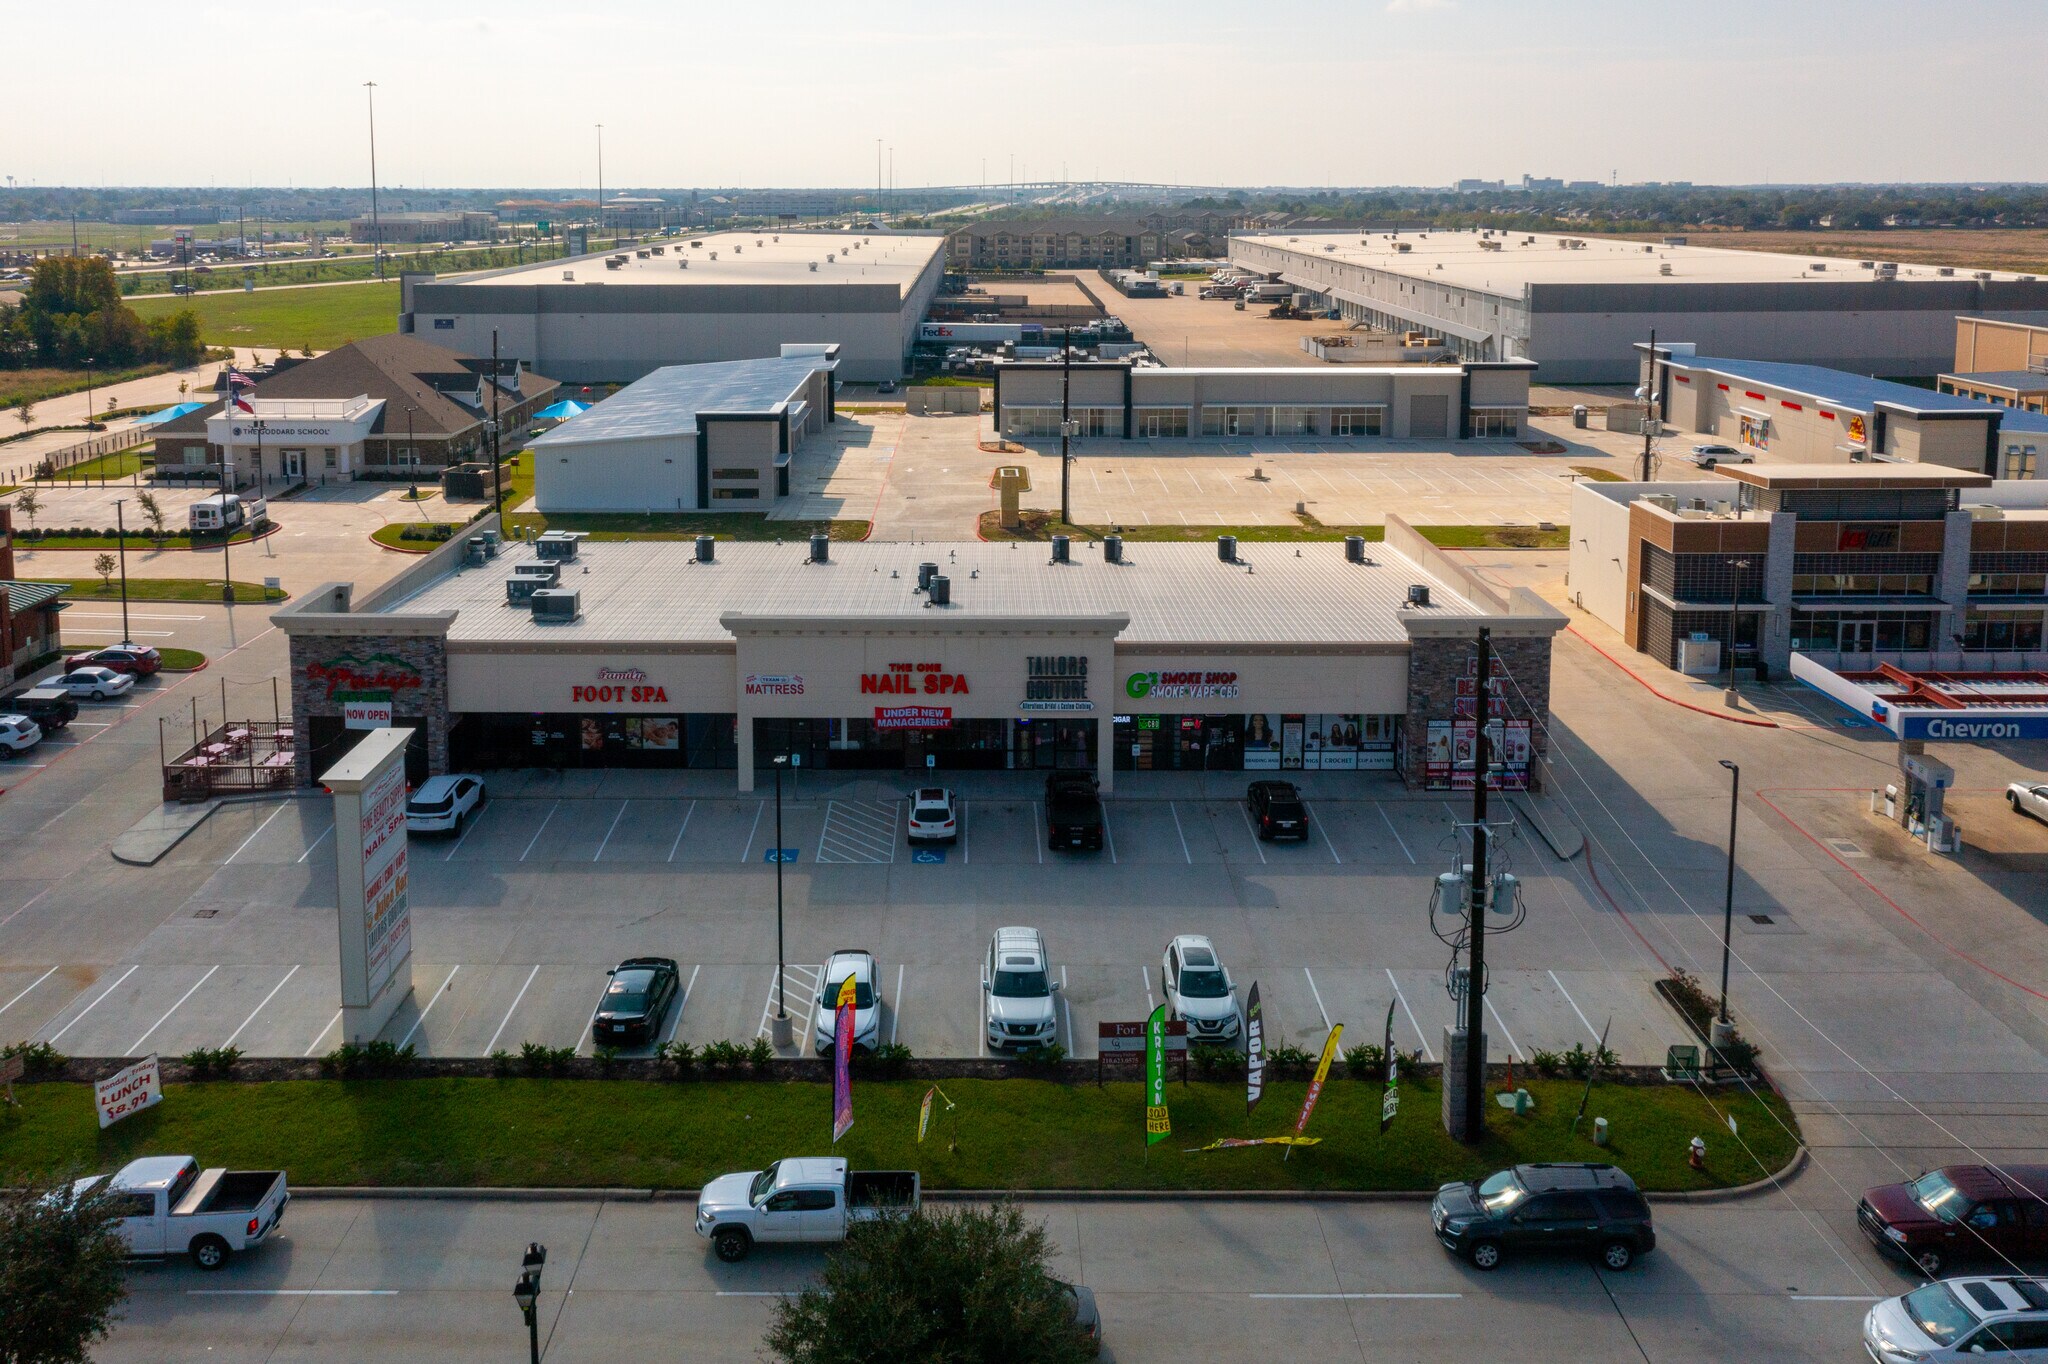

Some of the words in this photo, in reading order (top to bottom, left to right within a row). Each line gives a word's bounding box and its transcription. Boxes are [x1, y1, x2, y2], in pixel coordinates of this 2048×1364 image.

[922, 327, 953, 337] FedEx
[888, 663, 913, 673] THE
[916, 663, 942, 673] ONE
[1026, 656, 1088, 675] TAILORS
[1468, 657, 1503, 675] FE
[598, 667, 646, 682] Family
[1161, 672, 1203, 685] SMOKE
[1205, 672, 1238, 685] SHOP
[745, 684, 804, 695] MATTRESS
[861, 674, 917, 694] NAIL
[924, 674, 969, 694] SPA
[1026, 680, 1088, 699] COUTURE
[1151, 685, 1185, 698] SMOKE
[1189, 685, 1216, 698] VAPE
[1219, 685, 1240, 698] CBD
[1456, 678, 1509, 695] BETY
[572, 686, 625, 702] FOOT
[631, 686, 668, 702] SPA
[883, 708, 919, 718] UNDER
[921, 708, 944, 718] NEW
[1455, 698, 1505, 715] SULY
[346, 709, 366, 720] NOW
[367, 710, 390, 721] OPEN
[877, 718, 950, 727] MANAGEMENT
[1147, 720, 1159, 728] CBD
[1927, 719, 2020, 738] Chevron
[365, 832, 386, 859] NAIL
[388, 811, 405, 834] SPA
[374, 888, 394, 921] Juice
[395, 871, 408, 897] Bar
[1115, 1024, 1136, 1035] For
[1248, 1019, 1262, 1102] VAPOR
[99, 1075, 128, 1093] Monday
[131, 1062, 156, 1075] Friday
[102, 1075, 150, 1105] LUNCH
[107, 1091, 147, 1119] $8.99
[1149, 1120, 1170, 1132] HERE
